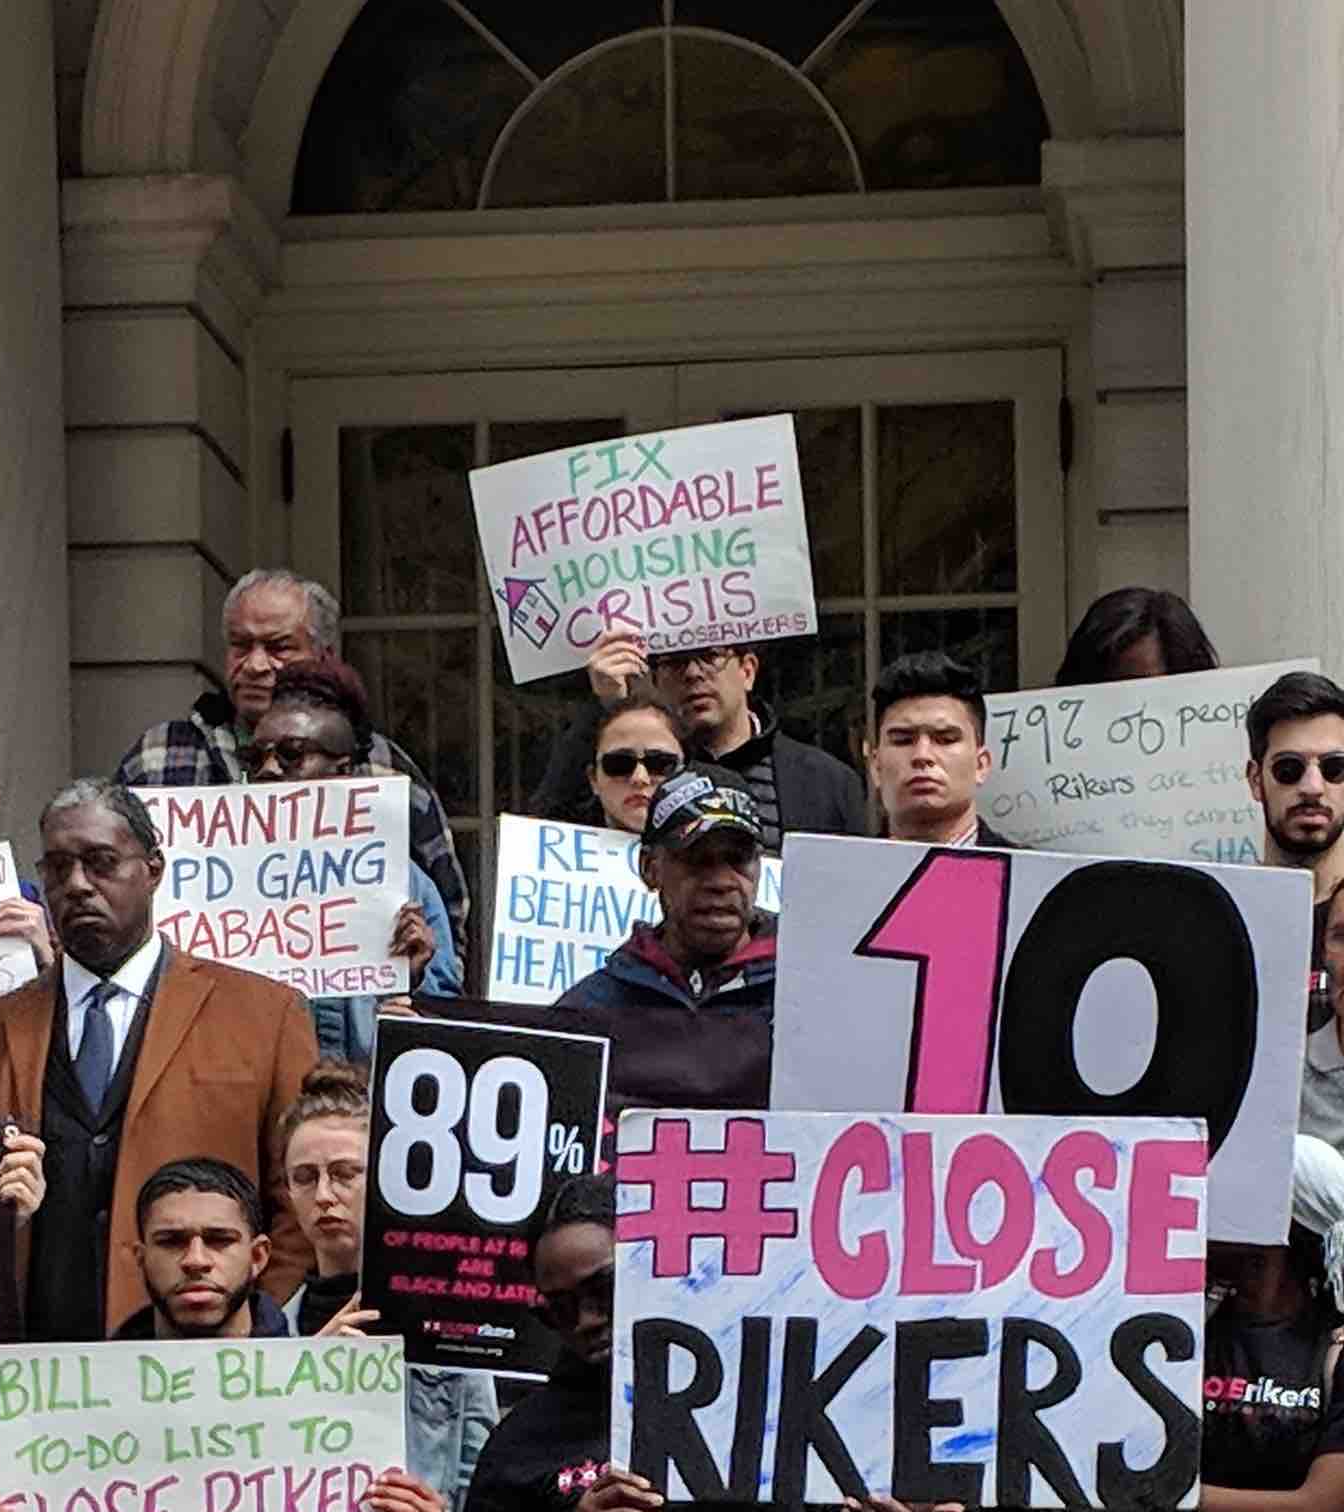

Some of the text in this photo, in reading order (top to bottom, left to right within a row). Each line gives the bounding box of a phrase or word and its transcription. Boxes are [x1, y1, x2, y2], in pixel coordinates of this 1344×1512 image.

[568, 439, 672, 493] FIX
[511, 464, 783, 568] AFFORDABLE
[554, 528, 756, 603] HOUSING
[566, 571, 755, 648] CRISIS
[992, 699, 1084, 771] 79%
[1047, 772, 1135, 804] Rikers
[257, 840, 386, 900] GANG
[854, 847, 1259, 1161] 10
[413, 1232, 481, 1251] PEOPLE
[616, 1117, 1207, 1300] #CLOSE
[389, 1275, 448, 1294] BLACK
[453, 1280, 493, 1299] AND
[216, 1345, 404, 1400] BLASIO'S
[16, 1416, 353, 1475] TO-DO LIST TO
[632, 1313, 1201, 1512] RIKERS
